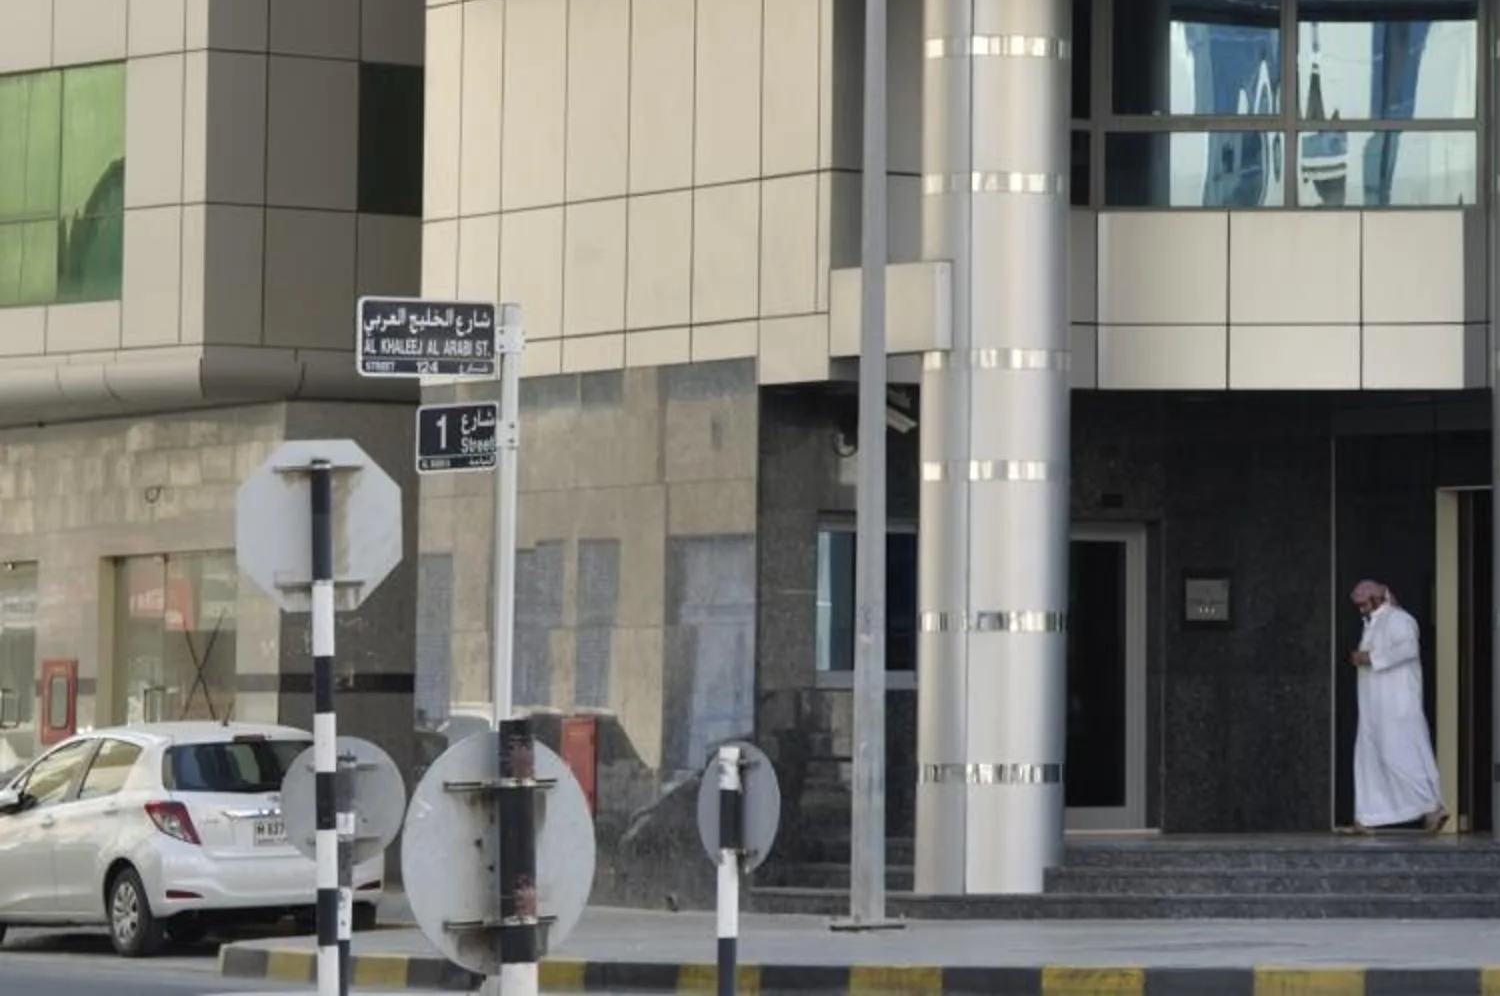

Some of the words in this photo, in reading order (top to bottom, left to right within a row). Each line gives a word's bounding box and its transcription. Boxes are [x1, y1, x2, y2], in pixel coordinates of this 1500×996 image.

[363, 307, 407, 337] العربي
[408, 307, 454, 334] الخليج
[455, 308, 491, 337] شارع
[363, 339, 377, 354] AL
[380, 338, 423, 355] KHALEEJ
[426, 339, 440, 355] AL
[443, 339, 473, 356] ARABI
[475, 339, 491, 357] ST.
[416, 361, 439, 373] 124
[435, 414, 447, 450] 1
[461, 408, 496, 435] شارع
[461, 435, 497, 454] Street
